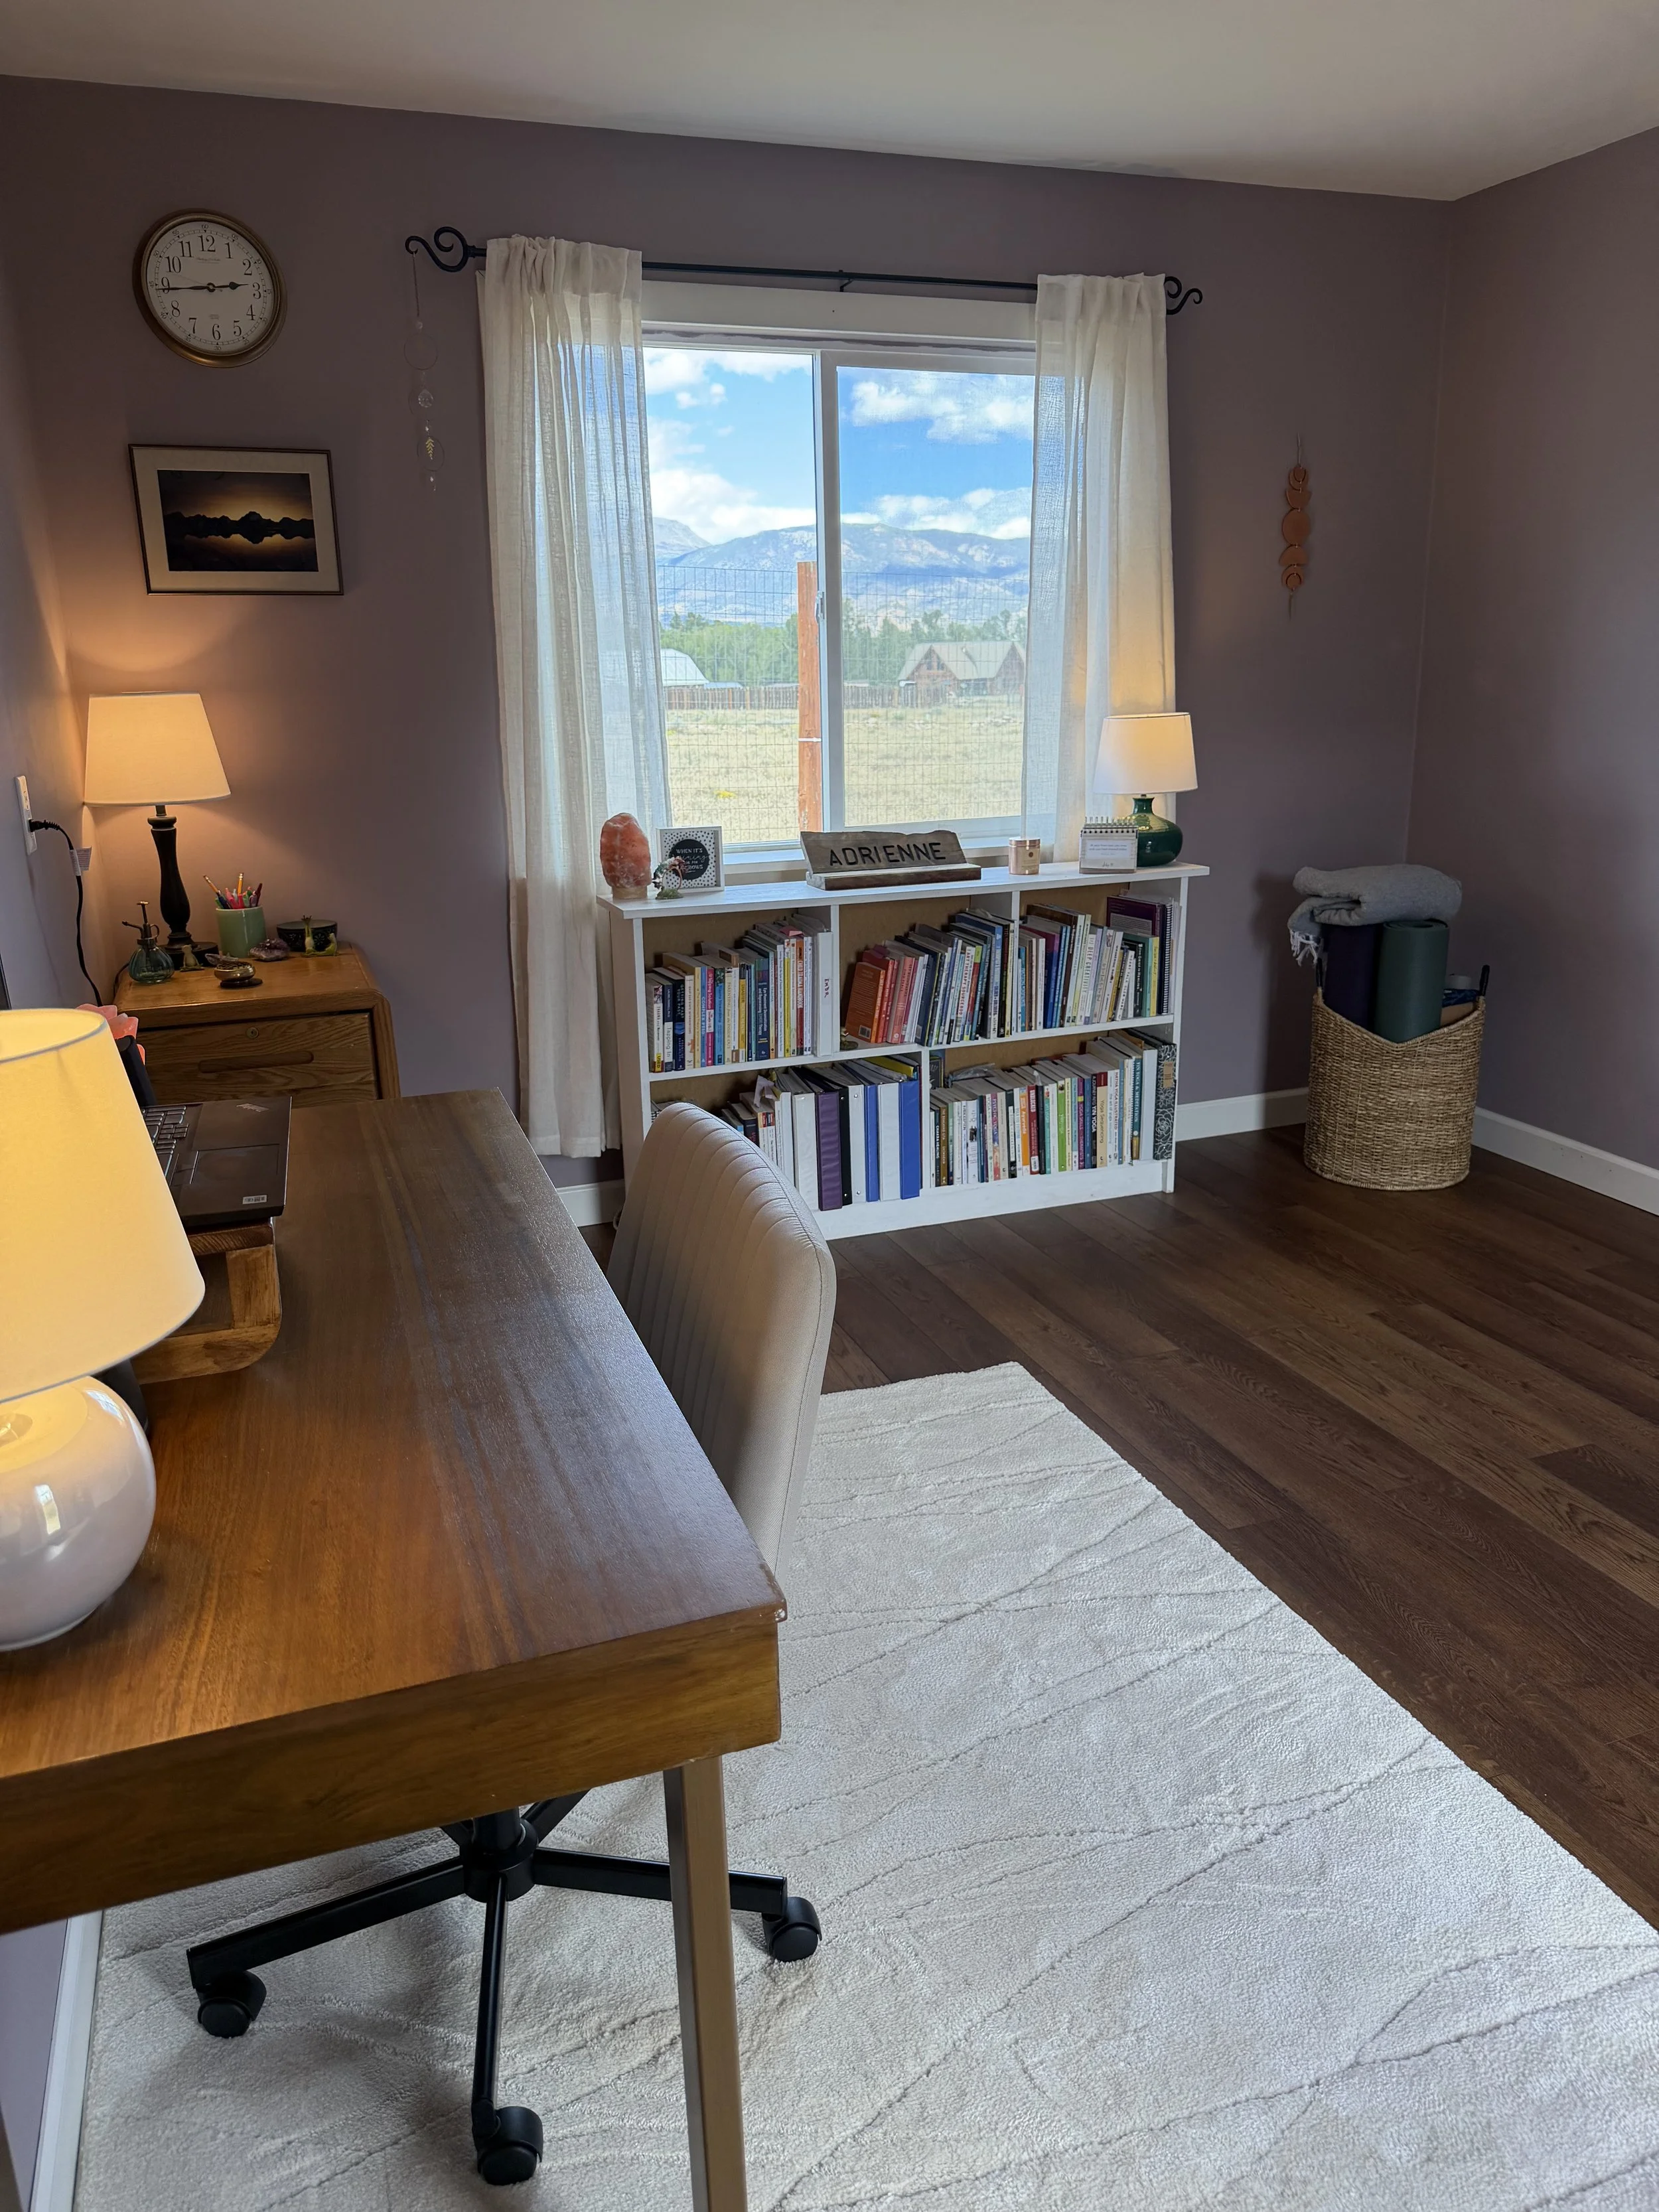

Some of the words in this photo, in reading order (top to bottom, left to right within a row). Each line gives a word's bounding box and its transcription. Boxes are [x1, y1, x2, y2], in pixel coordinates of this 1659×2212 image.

[178, 240, 194, 258] 11
[197, 234, 216, 252] 12
[224, 242, 234, 259] 1
[165, 255, 181, 273] 10
[242, 258, 252, 275] 2
[161, 276, 170, 294] 9
[252, 281, 261, 299] 3
[171, 299, 180, 317] 8
[246, 303, 256, 321] 4
[188, 317, 197, 334] 7
[212, 323, 221, 340] 6
[233, 320, 242, 336] 5
[829, 842, 947, 866] ADRIENNE
[1082, 961, 1092, 993] CREATIVITY
